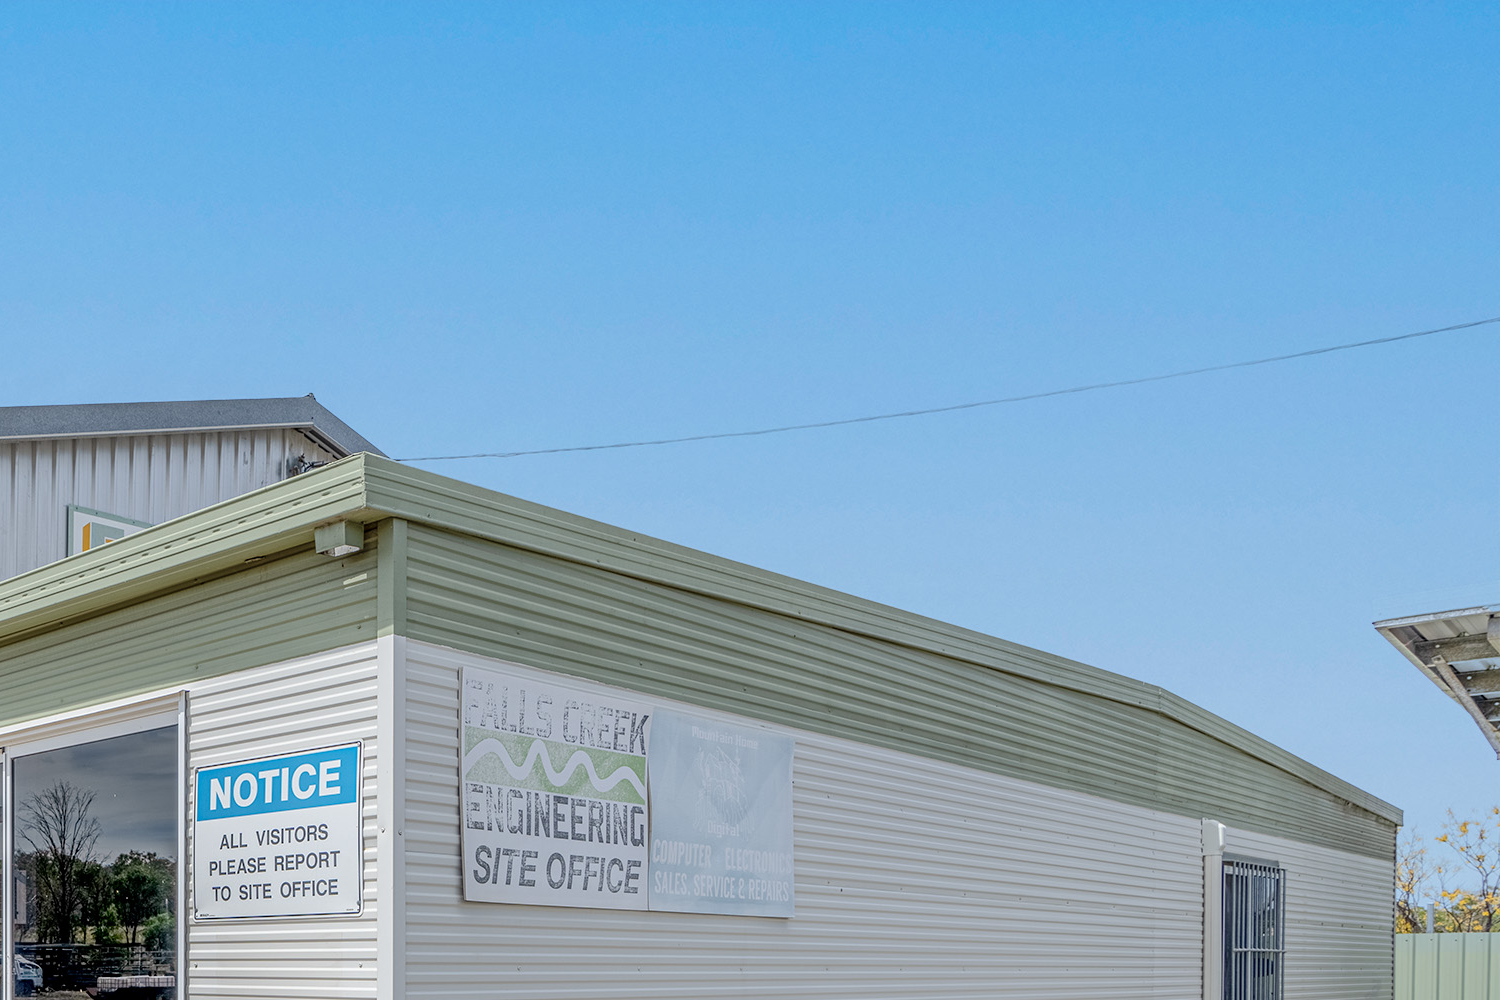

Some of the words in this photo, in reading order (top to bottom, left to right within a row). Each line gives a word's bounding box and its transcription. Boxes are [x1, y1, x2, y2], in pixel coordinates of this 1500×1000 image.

[465, 678, 552, 738] FALLS
[563, 699, 649, 755] CREEK
[691, 725, 733, 744] Mountain
[735, 735, 759, 750] Home
[209, 759, 341, 811] NOTICE
[465, 782, 645, 847] ENGINEERING
[219, 832, 248, 850] ALL
[256, 823, 329, 846] VISITORS
[707, 820, 740, 838] Digital
[209, 857, 266, 877] PLEASE
[274, 850, 340, 872] REPORT
[473, 845, 538, 887] SITE
[546, 852, 642, 894] OFFICE
[652, 839, 712, 868] COMPUTER
[725, 847, 792, 874] ELECTRONICS
[212, 885, 231, 902] TO
[239, 883, 272, 901] SITE
[280, 879, 338, 898] OFFICE
[693, 874, 735, 899] SERVICE
[748, 879, 789, 902] REPAIRS
